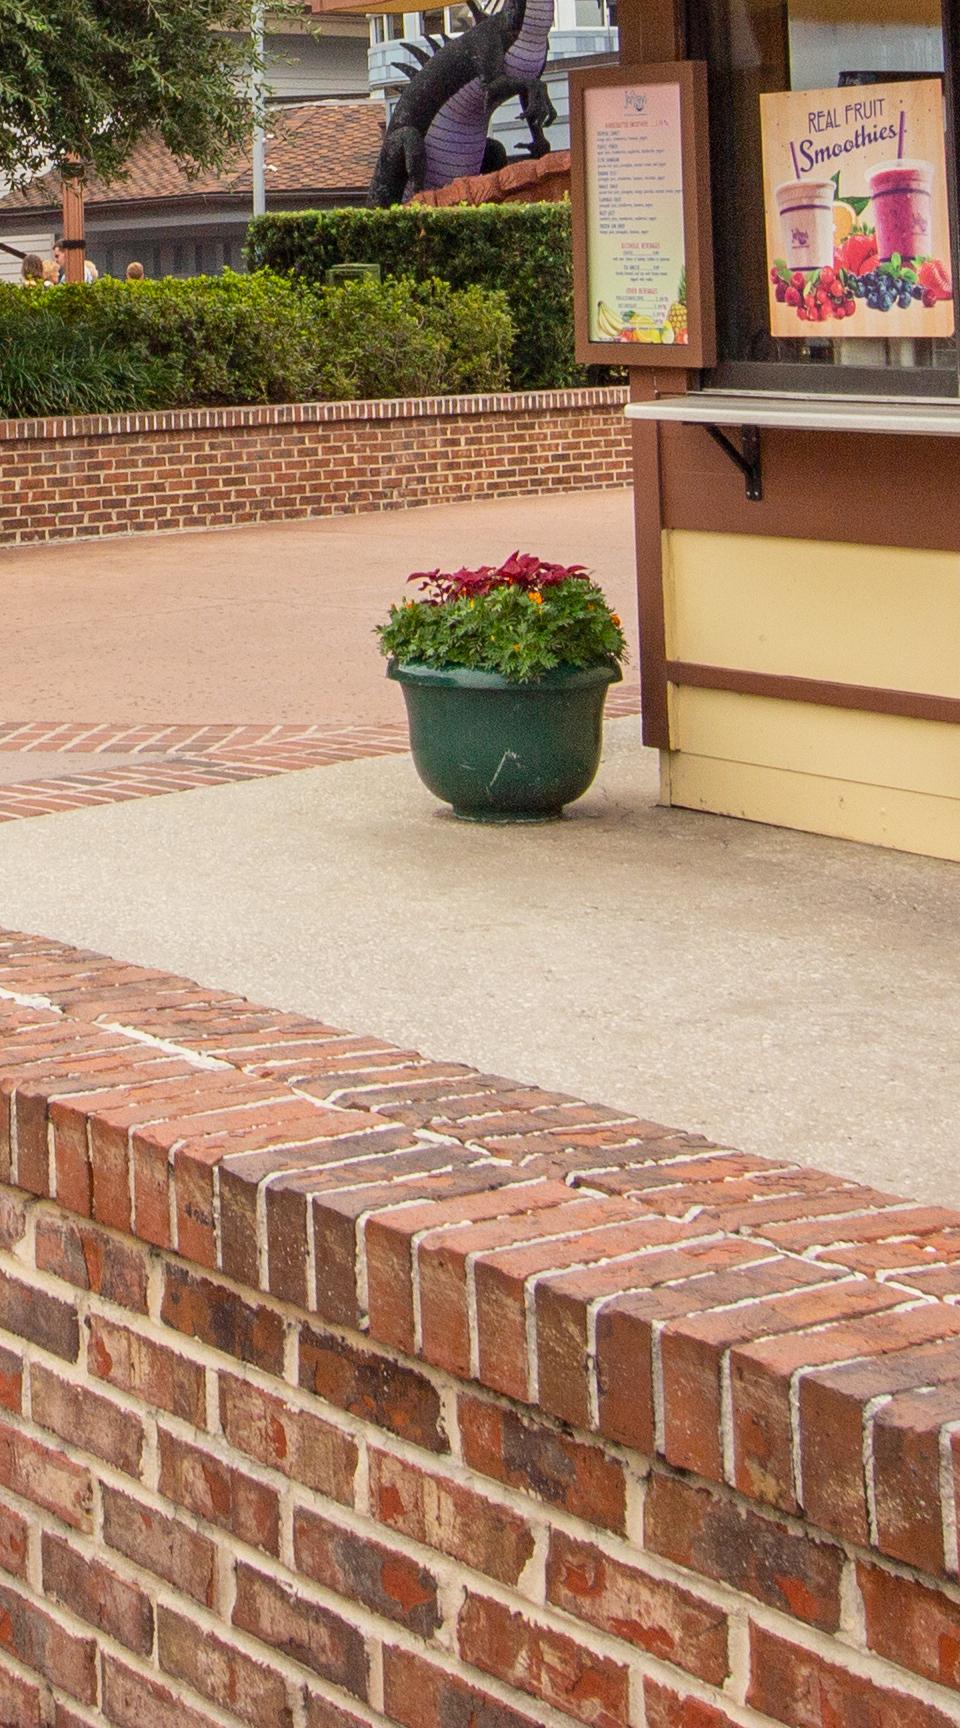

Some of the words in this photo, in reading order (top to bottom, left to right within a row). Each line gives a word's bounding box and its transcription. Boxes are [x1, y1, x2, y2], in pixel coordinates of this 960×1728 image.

[807, 107, 841, 133] REAL
[844, 97, 886, 124] FRUIT
[799, 123, 898, 173] Smoothies
